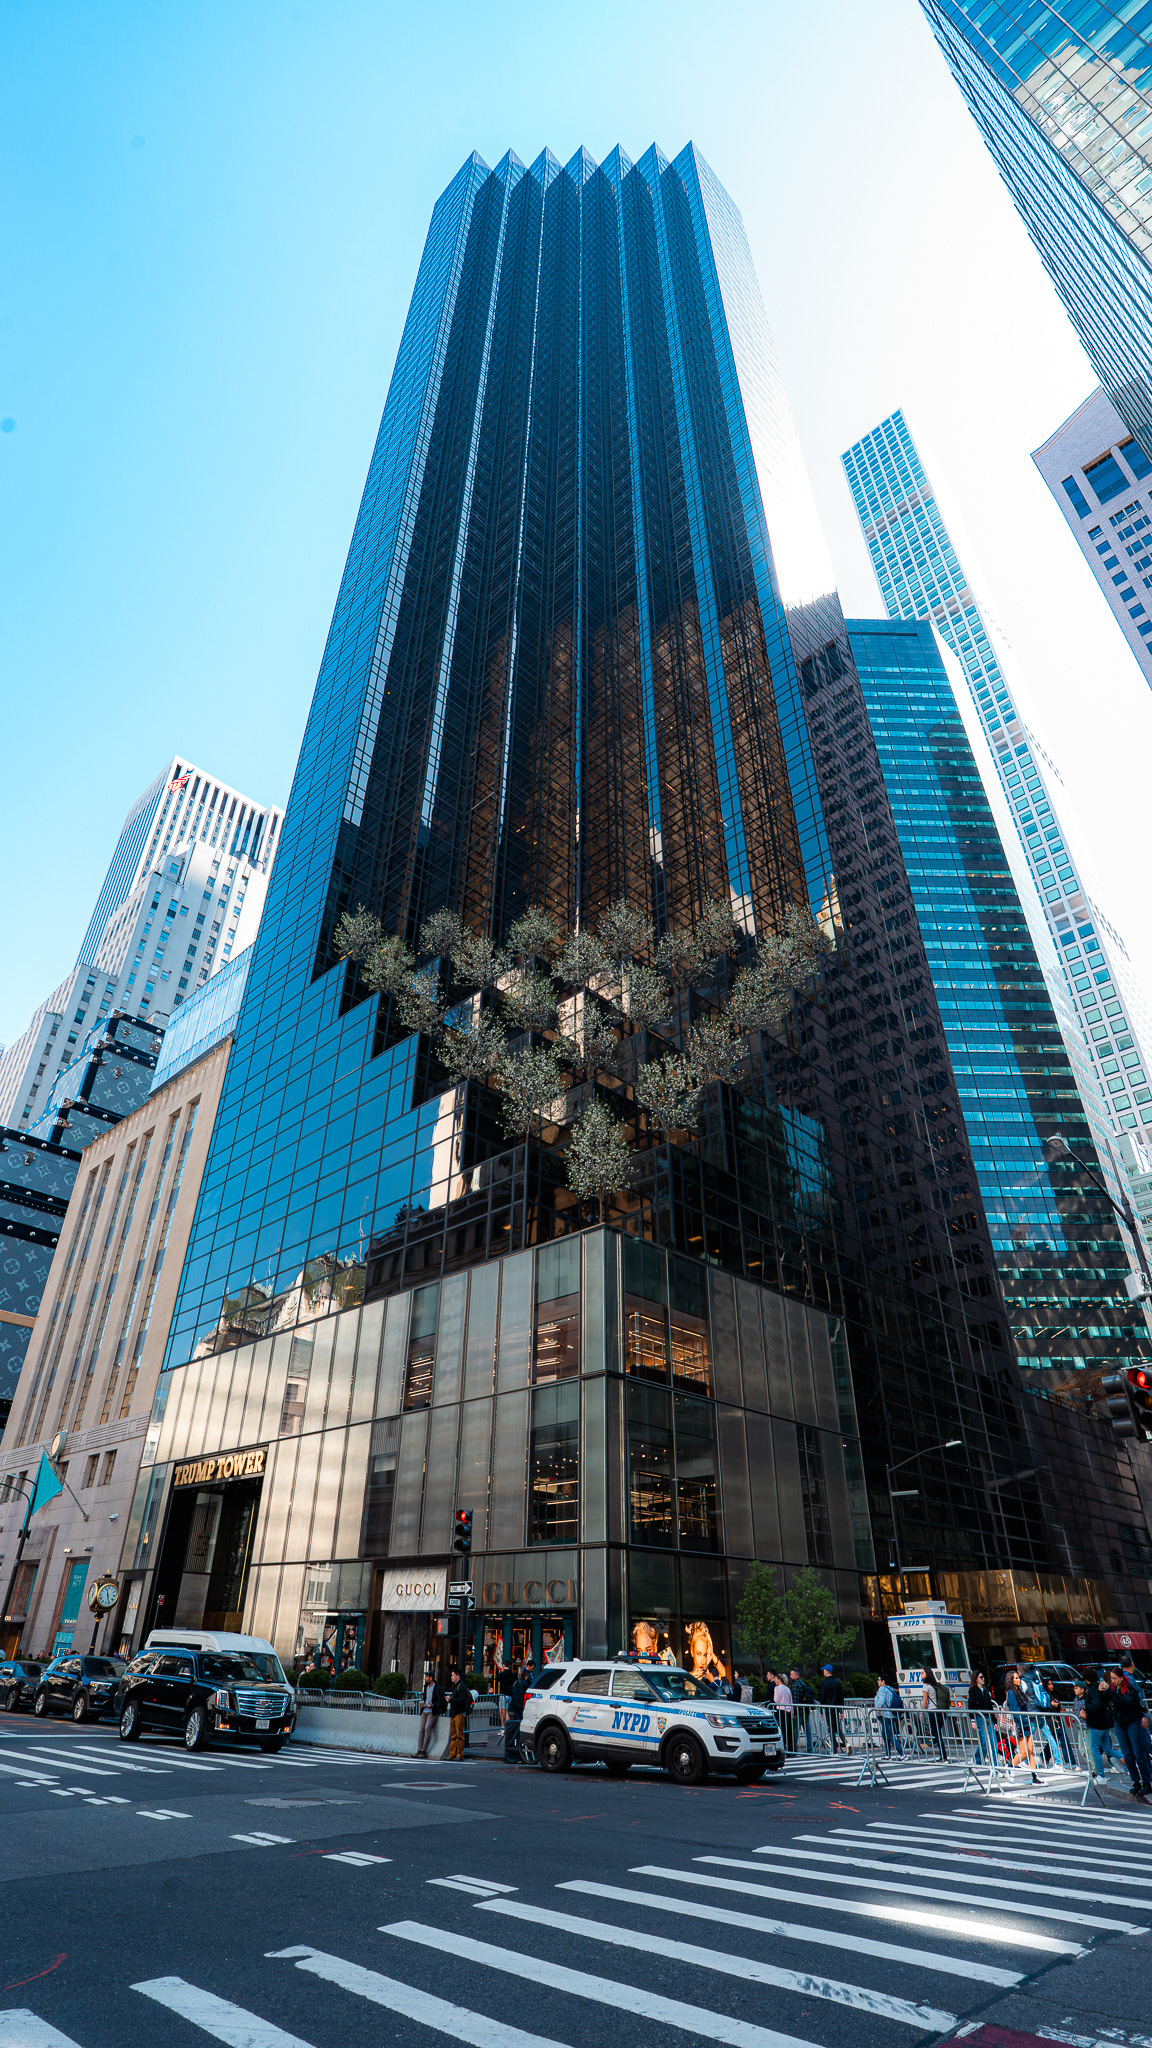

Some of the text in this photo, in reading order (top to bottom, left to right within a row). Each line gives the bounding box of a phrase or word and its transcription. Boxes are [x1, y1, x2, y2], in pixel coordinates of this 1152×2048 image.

[174, 1450, 265, 1486] TRUMP TOWER
[396, 1582, 438, 1596] GUCCI
[482, 1579, 572, 1604] GUCCI
[903, 1619, 920, 1627] NYPD
[909, 1672, 924, 1682] NY
[679, 1709, 697, 1718] POLICE
[611, 1711, 650, 1733] NYPD
